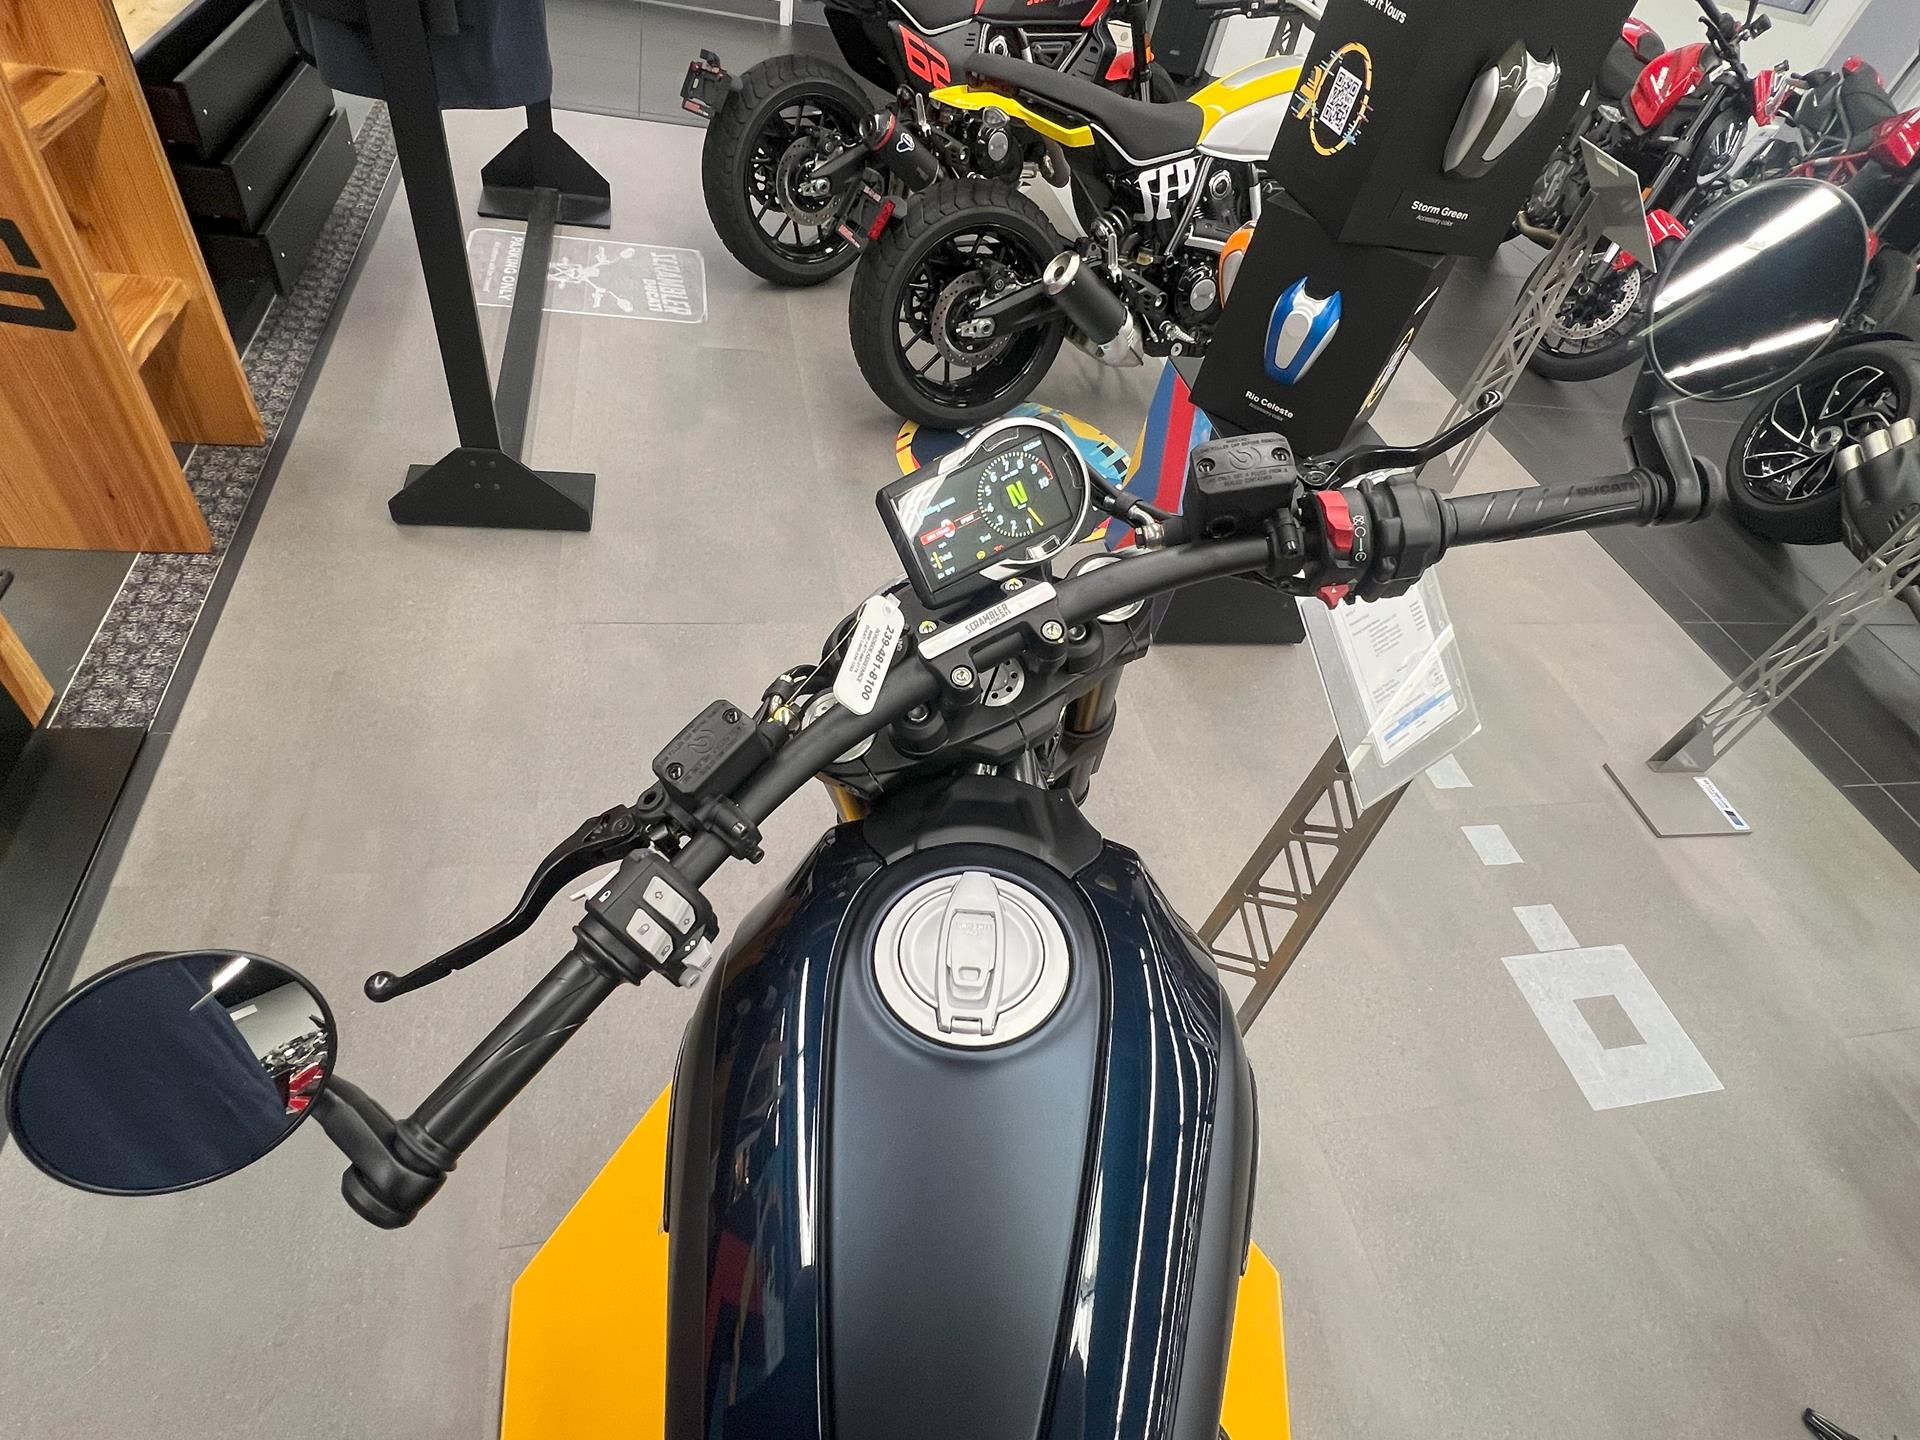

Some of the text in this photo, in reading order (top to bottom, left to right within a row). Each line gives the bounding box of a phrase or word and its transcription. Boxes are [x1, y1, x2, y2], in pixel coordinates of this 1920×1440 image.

[1383, 0, 1407, 24] Yours
[898, 24, 951, 88] 62
[1411, 200, 1469, 220] Storm Green
[498, 235, 524, 301] PARKING ONLY
[650, 252, 692, 316] SCRAMBLER
[642, 278, 664, 312] DUCATI
[1245, 390, 1294, 419] Rio Celeste
[1002, 460, 1010, 471] 7
[1016, 458, 1025, 470] 8
[1030, 464, 1038, 475] 9
[989, 471, 997, 483] 6
[1038, 477, 1051, 490] 10
[984, 485, 992, 497] 5
[1005, 480, 1029, 508] N
[986, 502, 994, 513] 4
[996, 514, 1004, 526] 3
[1010, 519, 1018, 531] 2
[964, 602, 1010, 634] SCRAMBLER
[861, 624, 895, 701] 239-481-8100
